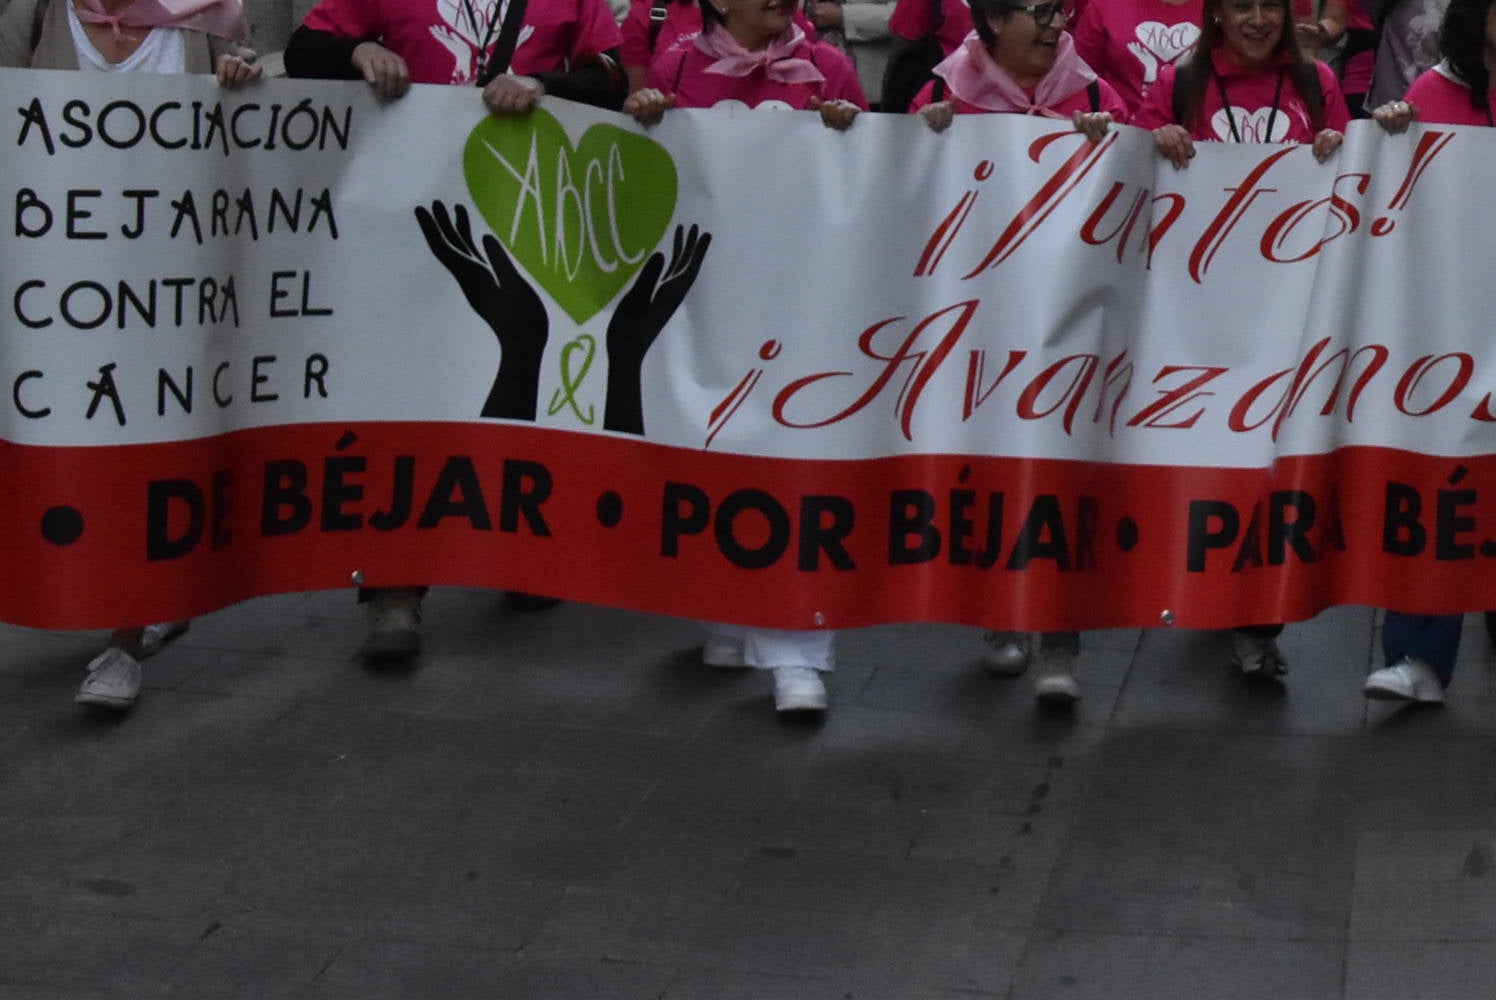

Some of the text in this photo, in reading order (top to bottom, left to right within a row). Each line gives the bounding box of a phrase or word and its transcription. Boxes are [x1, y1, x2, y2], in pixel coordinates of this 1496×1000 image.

[17, 98, 352, 155] ASOCIACIÓN
[15, 188, 338, 244] BEJARANA
[14, 271, 334, 329] CONTRA EL
[147, 466, 235, 562] DE
[261, 431, 554, 538] BÉJAR
[660, 480, 858, 572] POR
